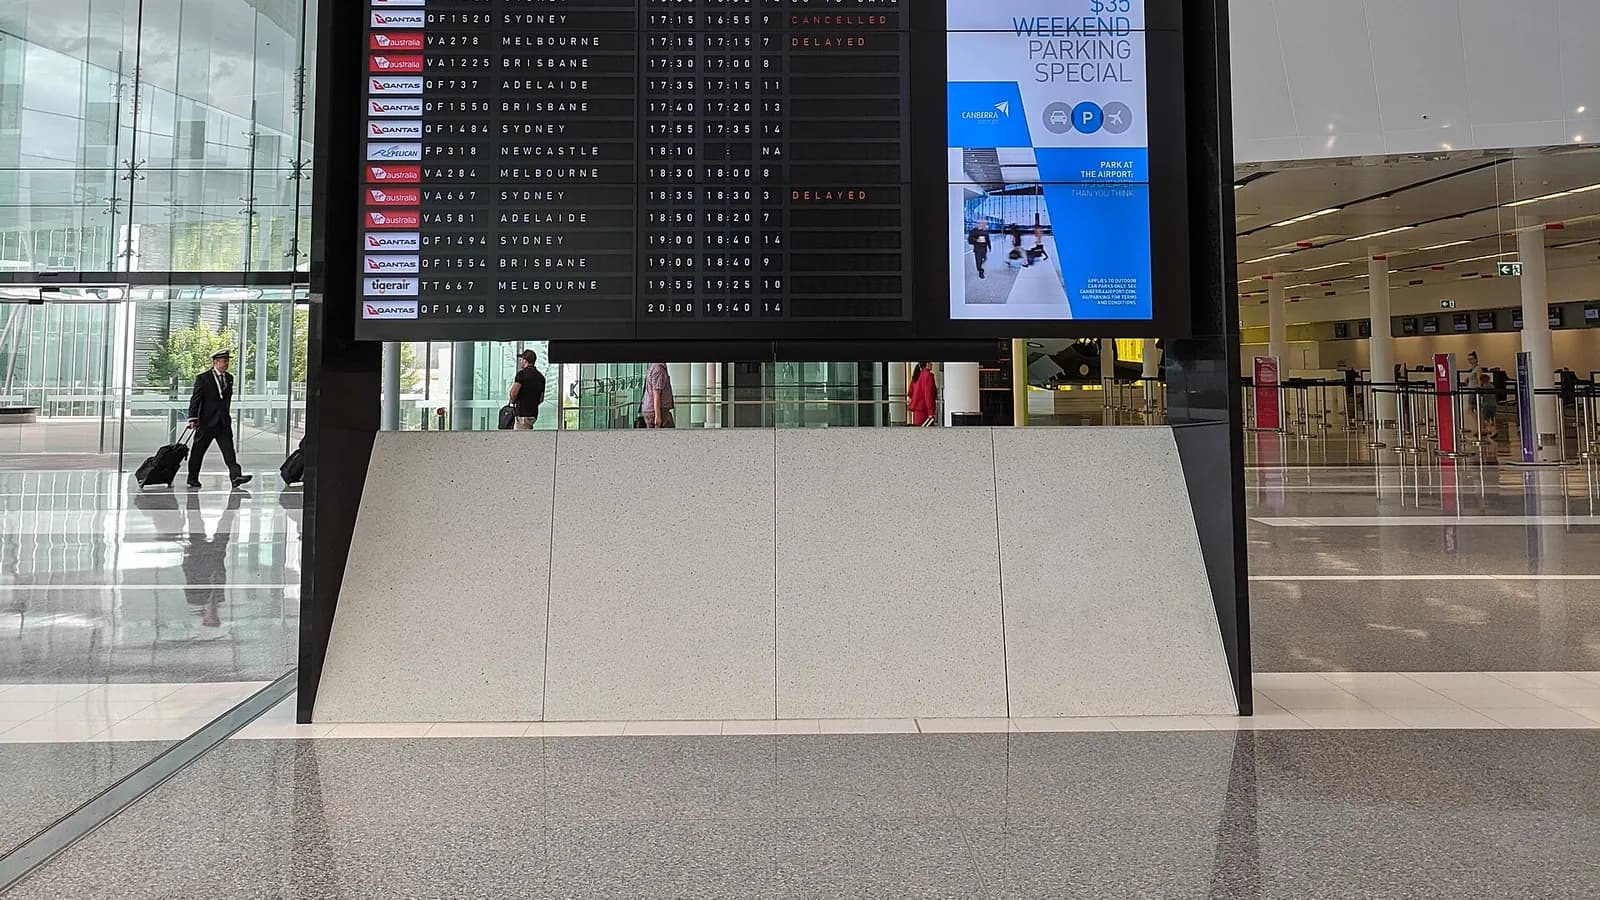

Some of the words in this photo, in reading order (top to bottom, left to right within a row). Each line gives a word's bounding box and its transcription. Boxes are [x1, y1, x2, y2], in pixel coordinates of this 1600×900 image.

[1090, 0, 1130, 15] $35
[428, 15, 489, 23] QF1520
[504, 15, 566, 23] SYDNEY
[651, 16, 693, 24] 17:15
[708, 16, 750, 24] 16:55
[764, 16, 768, 24] 9
[792, 16, 886, 24] CANCELLED
[1013, 17, 1130, 37] WEEKEND
[428, 37, 478, 45] VA278
[503, 37, 599, 45] MELBOURNE
[651, 38, 694, 46] 17:15
[708, 38, 749, 46] 17:15
[764, 38, 768, 46] 7
[792, 38, 864, 46] DELAYED
[1029, 40, 1131, 60] PARKING
[427, 58, 489, 66] VA1225
[504, 59, 587, 67] BRISBANE
[651, 59, 693, 67] 17:30
[708, 59, 749, 67] 17:00
[764, 59, 769, 67] 8
[1035, 63, 1133, 82] SPECIAL
[426, 80, 477, 88] QF737
[503, 81, 587, 89] ADELAIDE
[651, 81, 693, 89] 17:35
[708, 81, 750, 89] 17:15
[765, 81, 778, 89] 11
[426, 103, 488, 111] QF1550
[503, 103, 587, 111] BRISBANE
[651, 103, 693, 111] 17:40
[708, 103, 750, 111] 17:20
[765, 103, 780, 111] 13
[961, 111, 999, 119] CANBERRA
[426, 125, 487, 133] QF1484
[503, 125, 564, 133] SYDNEY
[651, 125, 693, 133] 17:55
[708, 125, 749, 133] 17:35
[765, 125, 780, 133] 14
[426, 147, 476, 155] FP318
[502, 147, 598, 155] NEWCASTLE
[650, 147, 692, 155] 18:10
[763, 147, 780, 155] NA
[1100, 161, 1122, 169] PARK
[1123, 161, 1134, 169] AT
[425, 169, 475, 177] VA284
[501, 169, 597, 177] MELBOURNE
[650, 169, 692, 177] 18:30
[708, 169, 749, 177] 18:00
[764, 169, 769, 177] 8
[1080, 170, 1097, 178] THE
[1097, 170, 1134, 178] AIRPORT:
[424, 192, 475, 200] VA667
[501, 192, 563, 200] SYDNEY
[650, 191, 692, 199] 18:35
[708, 192, 749, 200] 18:30
[764, 191, 769, 199] 3
[793, 191, 865, 199] DELAYED
[424, 214, 473, 222] VA581
[501, 214, 586, 222] ADELAIDE
[650, 213, 692, 221] 18:50
[708, 213, 750, 221] 18:20
[764, 213, 769, 221] 7
[423, 236, 485, 244] QF1494
[501, 236, 563, 244] SYDNEY
[650, 236, 692, 244] 19:00
[707, 236, 749, 244] 18:40
[765, 236, 780, 244] 14
[423, 259, 485, 267] QF1554
[500, 259, 585, 267] BRISBANE
[650, 258, 692, 266] 19:00
[707, 258, 749, 266] 18:40
[764, 258, 769, 266] 9
[372, 279, 410, 294] tigerair
[422, 282, 473, 290] TT667
[499, 281, 596, 289] MELBOURNE
[649, 281, 692, 289] 19:55
[707, 280, 750, 288] 19:25
[765, 280, 780, 288] 10
[421, 305, 484, 313] QF1498
[499, 304, 562, 312] SYDNEY
[648, 304, 692, 312] 20:00
[707, 303, 749, 311] 19:40
[765, 303, 780, 311] 14
